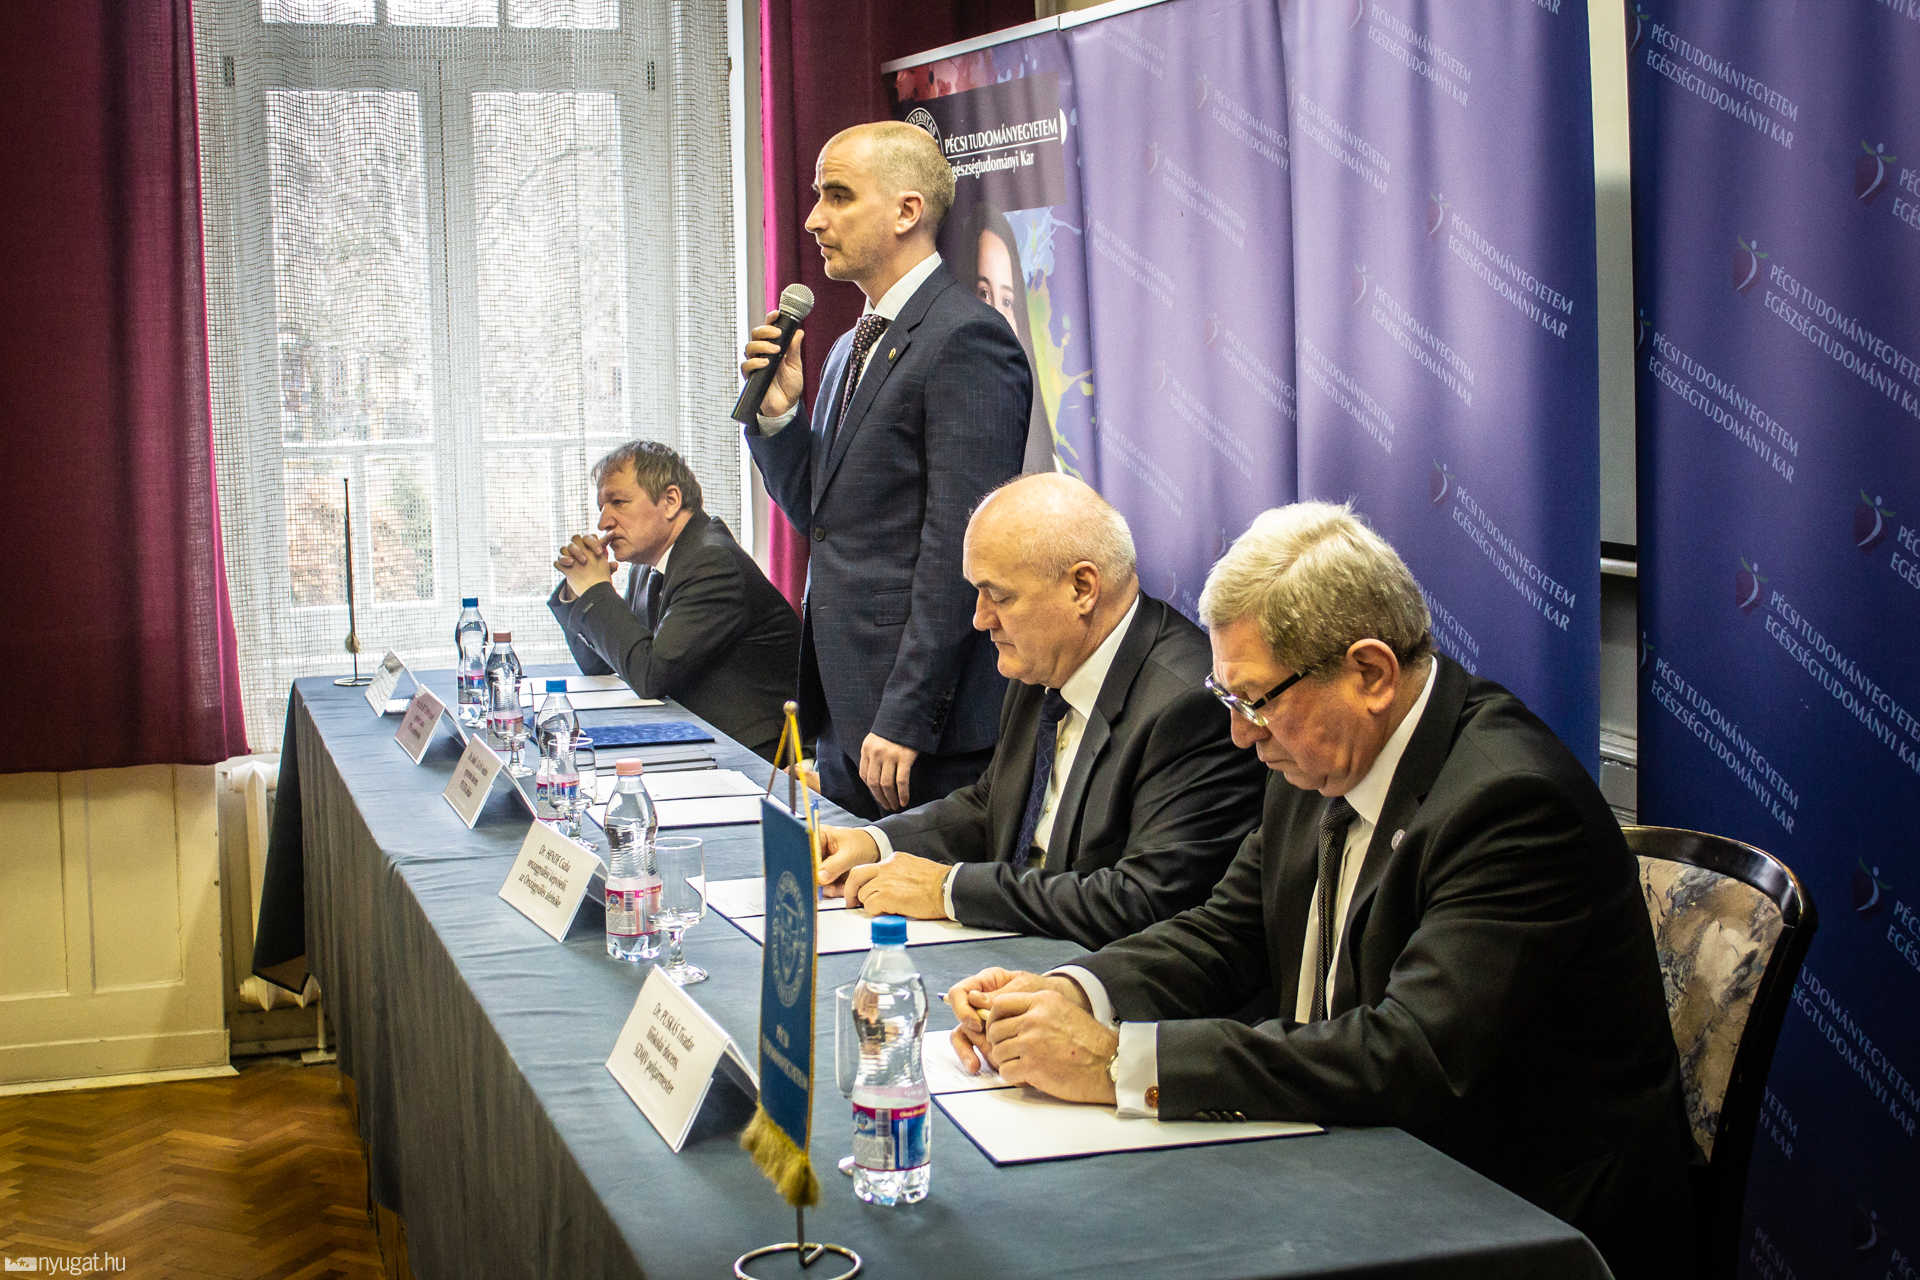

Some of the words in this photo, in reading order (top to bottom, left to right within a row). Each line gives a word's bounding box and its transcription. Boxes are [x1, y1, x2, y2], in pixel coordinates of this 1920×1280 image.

[1647, 49, 1770, 134] EGÉSZSÉGTUDOMÁNYI
[1771, 124, 1794, 150] KAR
[1651, 23, 1680, 53] PÉCSI
[1680, 39, 1799, 122] TUDOMÁNYEGYETEM
[944, 131, 968, 154] PÉCSI
[968, 118, 1059, 148] TUDOMÁNYEGYETEM
[950, 151, 1019, 182] gészségtudományi
[1020, 151, 1034, 167] Kar
[1899, 167, 1920, 197] PÉC
[1541, 312, 1568, 339] KAR
[1764, 290, 1901, 403] EGÉSZSÉGTUDOMÁNYI
[1901, 388, 1920, 422] KA
[1769, 264, 1801, 300] PÉCSI
[1801, 286, 1920, 387] TUDOMÁNYEGYETE
[1649, 356, 1771, 462] EGÉSZSÉGTUDOMÁNYI
[1771, 451, 1794, 484] KAR
[1652, 331, 1680, 365] PÉCSI
[1680, 351, 1799, 457] TUDOMÁNYEGYETEM
[1452, 506, 1542, 611] EGÉSZSÉGTUDOMÁNYI
[1543, 605, 1570, 631] KAR
[1456, 485, 1478, 517] PÉCSI
[1478, 508, 1576, 608] TUDOMÁNYEGYETEM
[1896, 524, 1920, 560] PÉC
[1416, 581, 1479, 658] MÁNYEGYETEM
[1770, 591, 1801, 629] PÉCSI
[1801, 618, 1920, 743] TUDOMÁNYEGYETE
[1656, 656, 1685, 694] PÉCSI
[1684, 685, 1799, 810] TUDOMÁNYEGYETEM
[1764, 614, 1897, 751] EGÉSZSÉGTUDOMÁNYI
[1650, 679, 1771, 808] EGÉSZSÉGTUDOMÁNYI
[1771, 800, 1795, 835] KAR
[1893, 899, 1920, 938] PÉC
[1792, 983, 1888, 1105] SÉGTUDOMÁNYI
[1889, 1100, 1916, 1137] KAR
[1802, 963, 1920, 1113] UDOMÁNYEGYETEM
